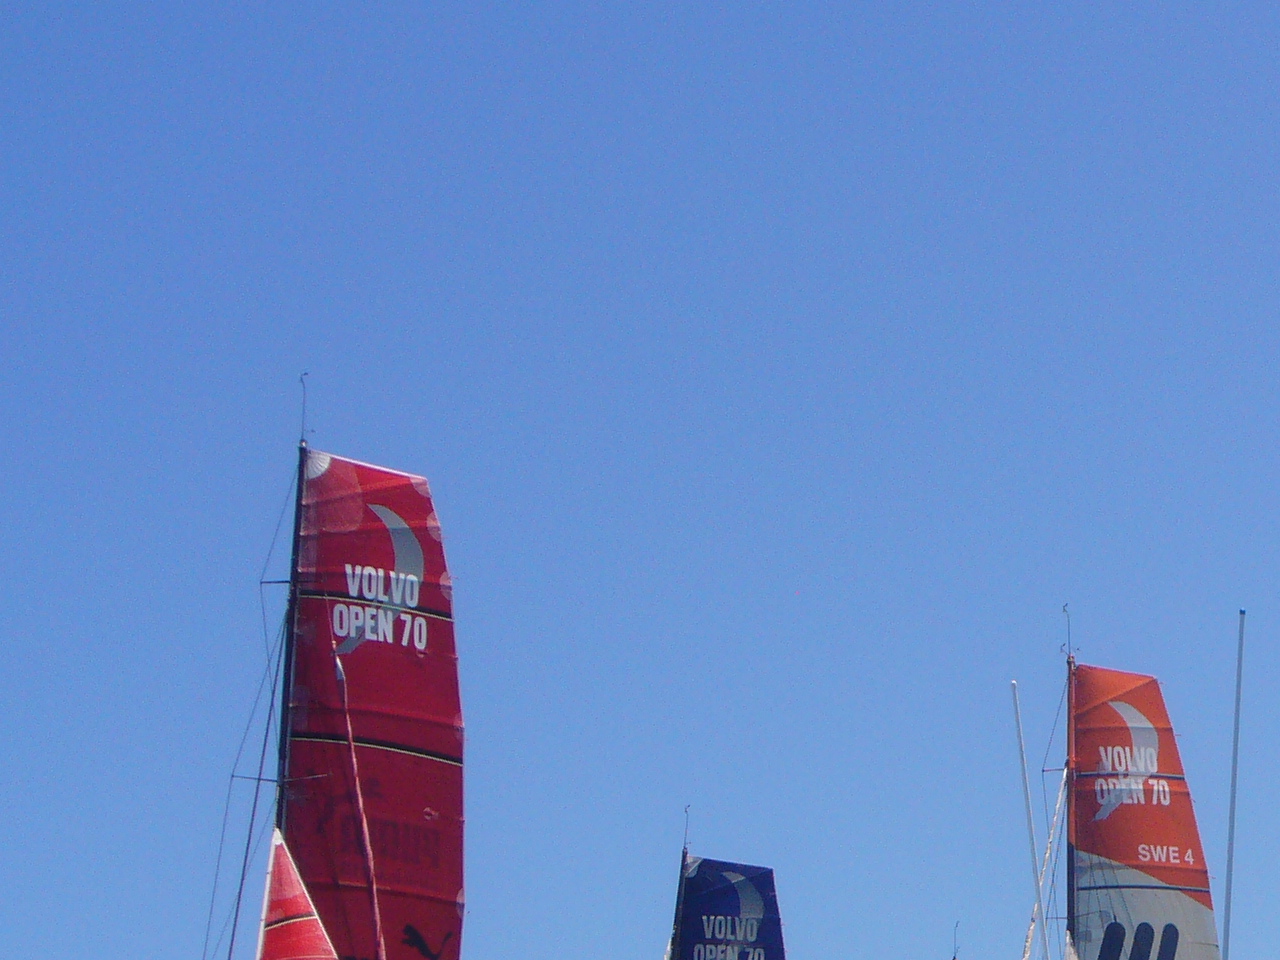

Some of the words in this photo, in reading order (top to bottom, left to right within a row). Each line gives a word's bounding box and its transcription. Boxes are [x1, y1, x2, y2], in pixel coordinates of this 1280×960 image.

[344, 564, 420, 608] VOLVO
[332, 604, 394, 643] OPEN
[400, 614, 428, 650] 70
[1098, 745, 1158, 773] VOLVO
[1094, 778, 1145, 805] OPEN
[1148, 779, 1171, 806] 70
[1138, 844, 1180, 863] SWE
[1184, 848, 1195, 865] 4
[702, 915, 759, 942] VOLVO
